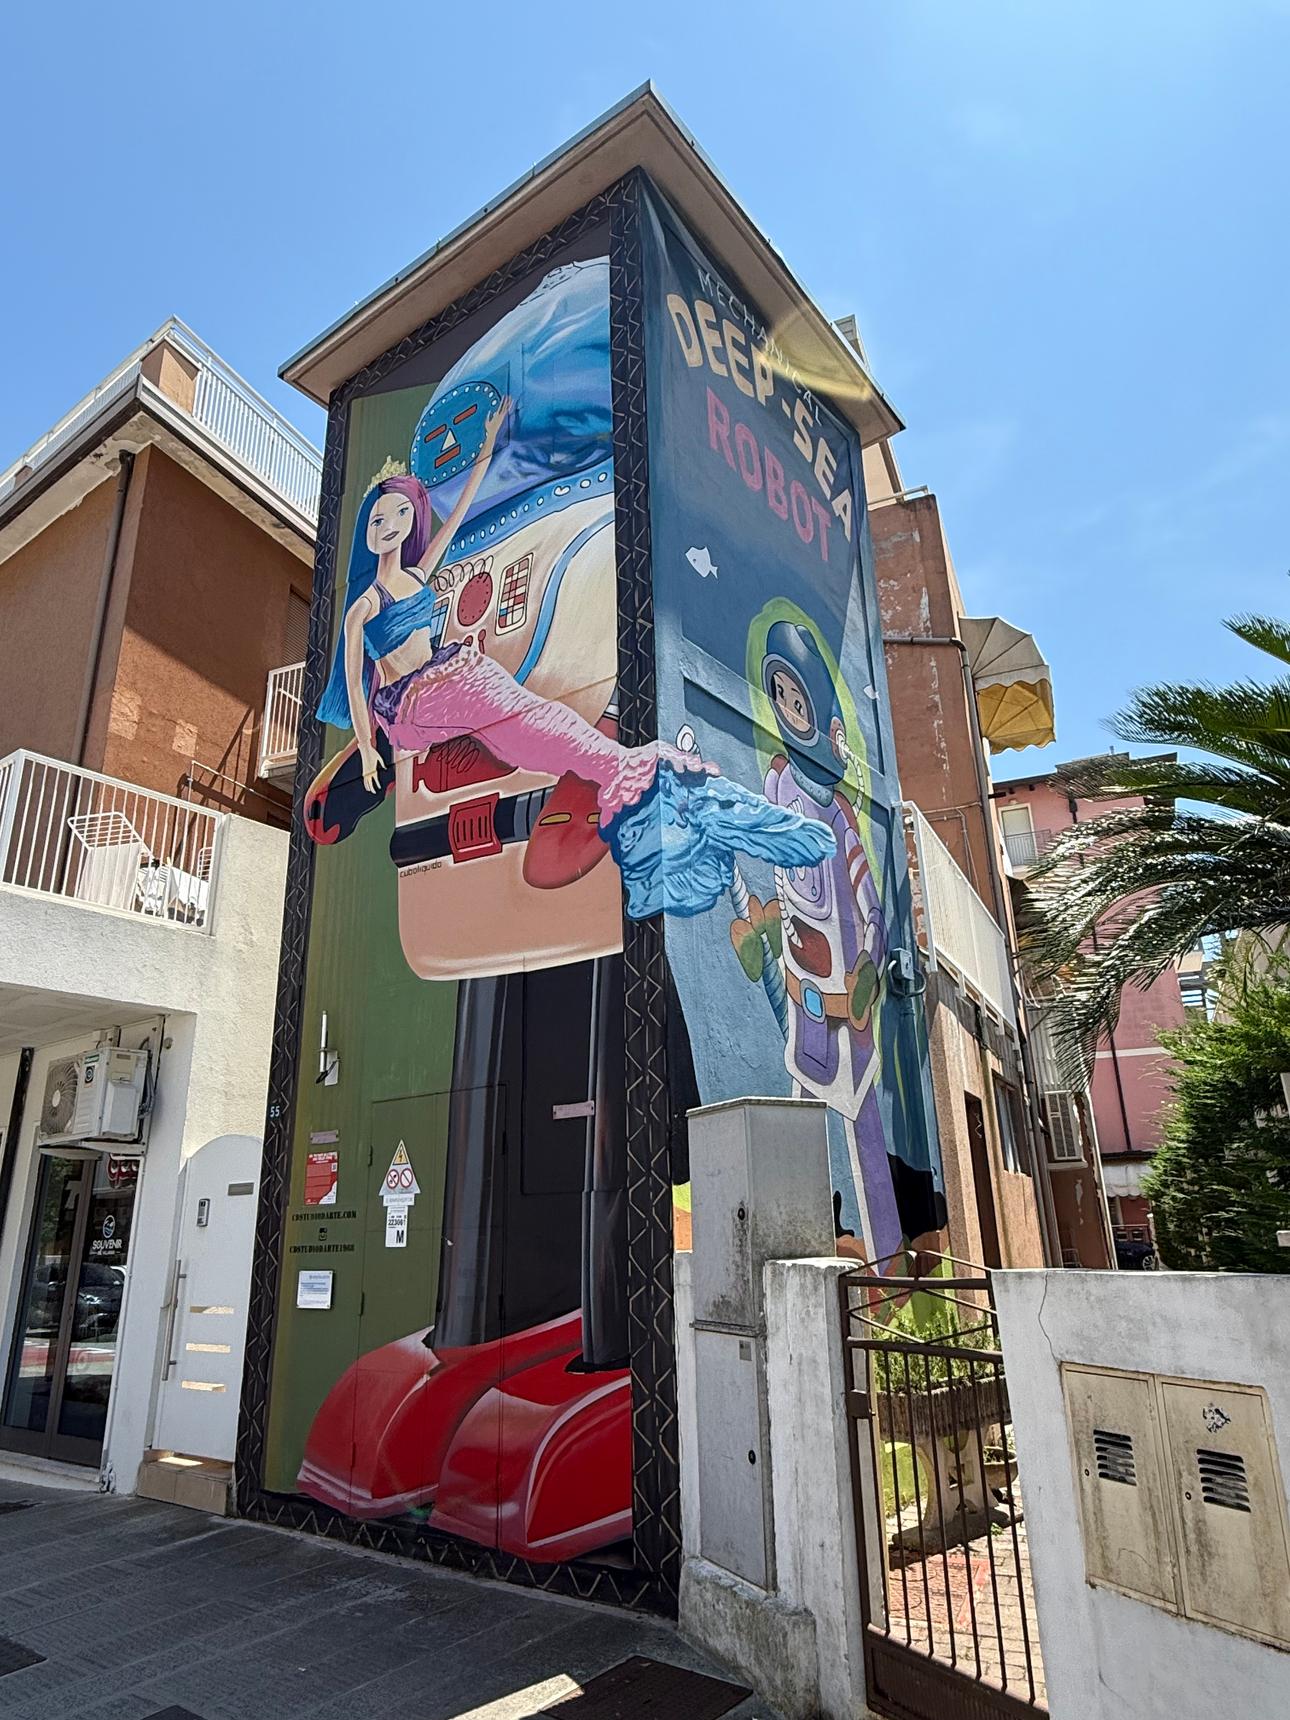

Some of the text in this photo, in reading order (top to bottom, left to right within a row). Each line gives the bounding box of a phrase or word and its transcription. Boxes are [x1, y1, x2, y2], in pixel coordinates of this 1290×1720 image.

[697, 269, 822, 426] MECHANICAL
[706, 386, 832, 562] ROBOT
[270, 1105, 280, 1117] 55
[396, 1230, 404, 1243] M
[92, 1239, 122, 1250] SOUVENIR
